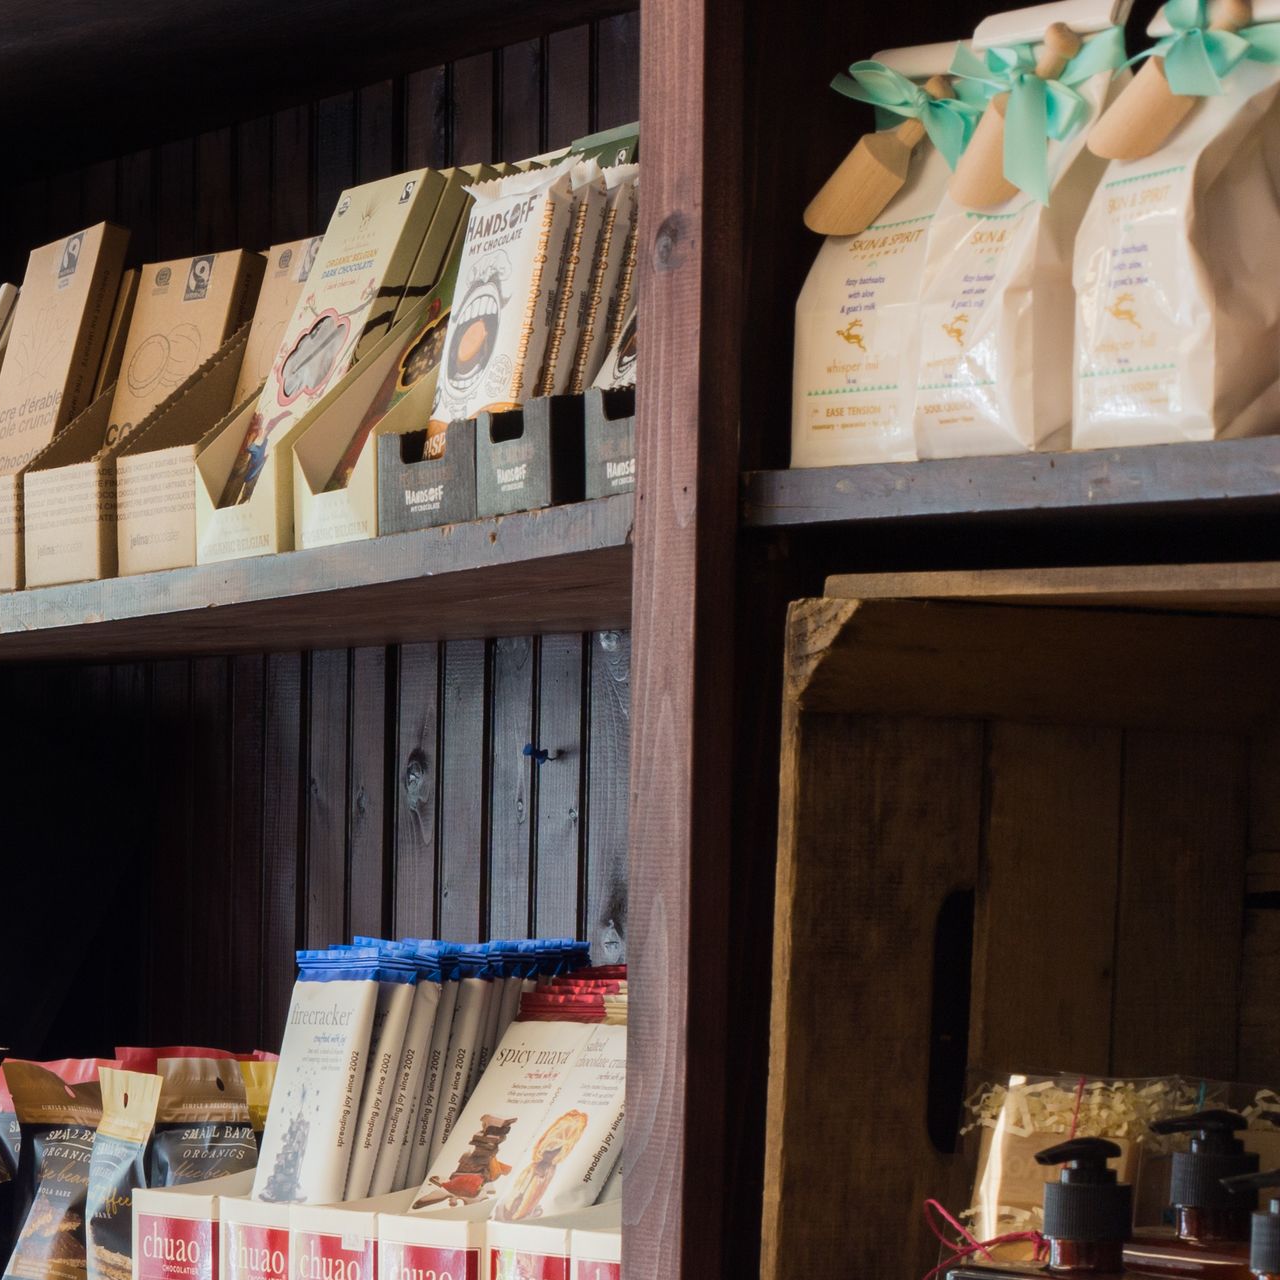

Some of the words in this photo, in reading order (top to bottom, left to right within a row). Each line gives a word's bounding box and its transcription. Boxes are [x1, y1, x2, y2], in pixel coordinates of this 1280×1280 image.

[466, 209, 508, 243] HANDS
[509, 196, 538, 229] OFF
[468, 244, 482, 257] MY
[483, 230, 523, 252] CHOCOLATE
[849, 236, 881, 252] SKIN
[889, 228, 925, 246] SPIRIT
[497, 468, 515, 485] HANDS
[514, 463, 528, 481] OFF
[606, 461, 630, 479] HANDS
[405, 487, 428, 506] HANDS
[427, 485, 444, 503] OFF
[290, 1002, 353, 1027] firecracker
[351, 1050, 360, 1073] 2002
[380, 1052, 392, 1076] 2002
[403, 1048, 416, 1072] 2002
[431, 1049, 441, 1073] 2002
[496, 1042, 535, 1068] spicy
[347, 1073, 356, 1094] since
[376, 1075, 386, 1096] since
[400, 1070, 410, 1092] since
[430, 1072, 438, 1094] since
[345, 1093, 354, 1110] joy
[373, 1095, 383, 1112] joy
[396, 1092, 406, 1108] joy
[426, 1092, 436, 1112] joy
[45, 1127, 79, 1143] SMALL
[181, 1127, 220, 1142] SMALL
[224, 1126, 256, 1142] BATC
[337, 1109, 351, 1148] spreading
[364, 1105, 380, 1150] spreading
[387, 1104, 403, 1146] spreading
[419, 1106, 433, 1147] spreading
[182, 1148, 245, 1161] ORGANICS
[583, 1143, 608, 1184] spreading
[604, 1129, 618, 1148] joy
[611, 1109, 626, 1131] since
[143, 1222, 200, 1264] chuao
[162, 1264, 198, 1275] CHOCOLATIER
